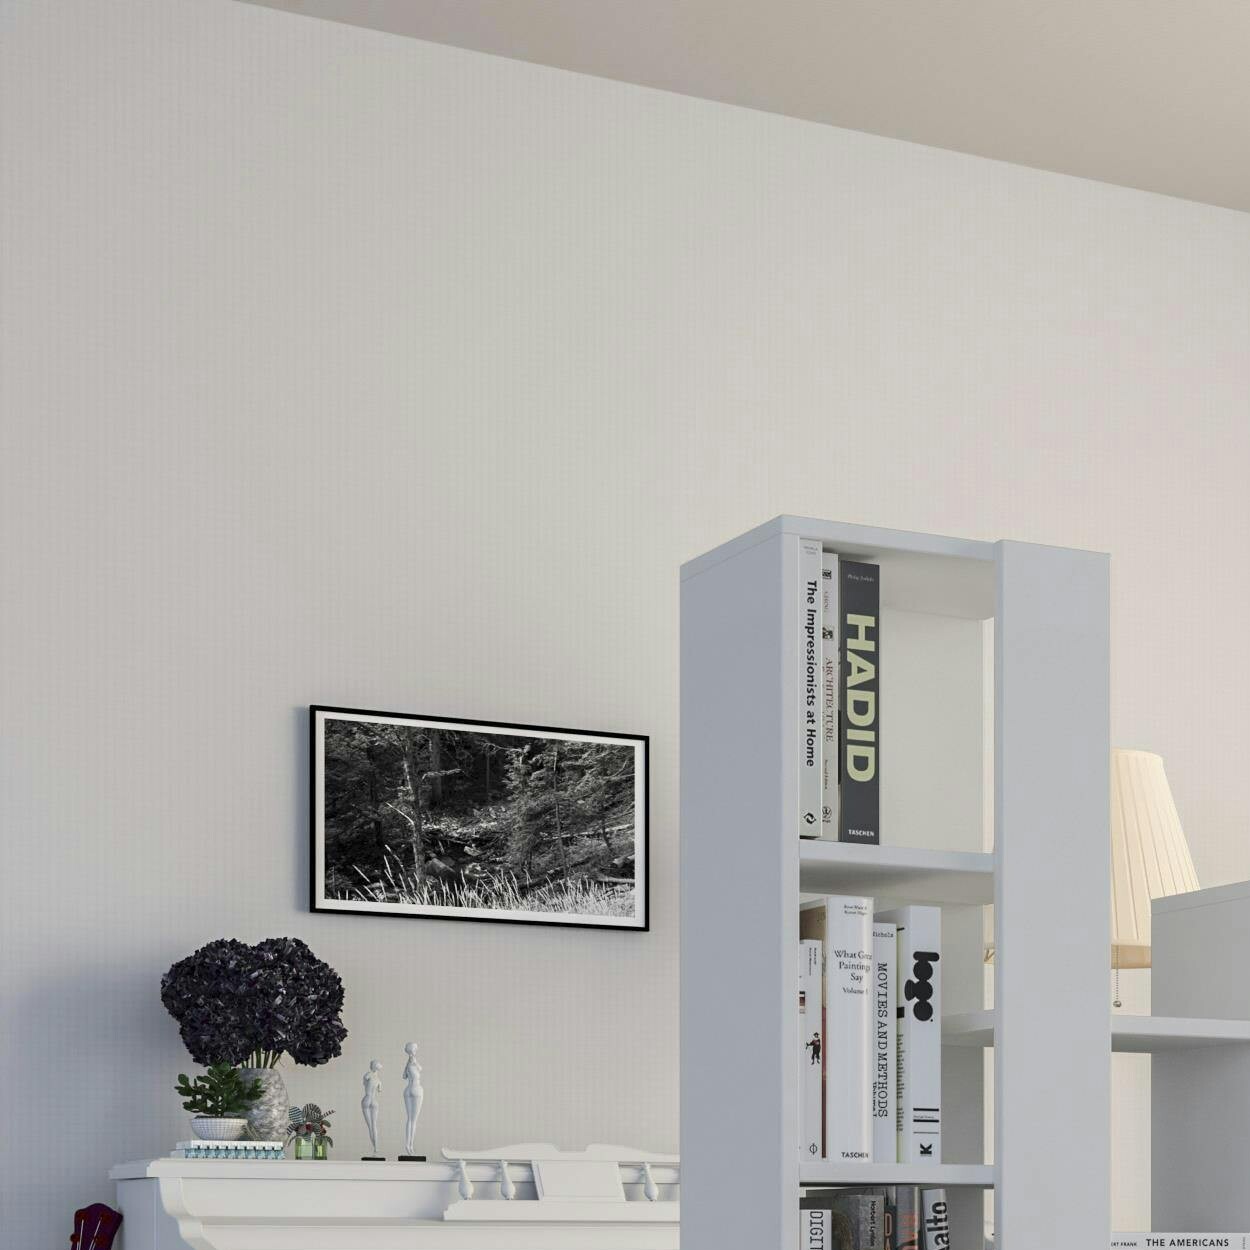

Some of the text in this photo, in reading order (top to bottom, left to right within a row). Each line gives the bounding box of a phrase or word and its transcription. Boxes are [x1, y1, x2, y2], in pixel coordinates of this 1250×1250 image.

[805, 580, 817, 767] The Impressionists at Home
[846, 613, 876, 783] HADID
[824, 657, 834, 743] ARCHITECTURE
[848, 829, 875, 837] TASCHEN
[834, 950, 857, 959] What
[850, 972, 864, 984] Say
[877, 962, 888, 1118] MOVIES AND METHODS
[1145, 1238, 1230, 1247] THE AMERICANS
